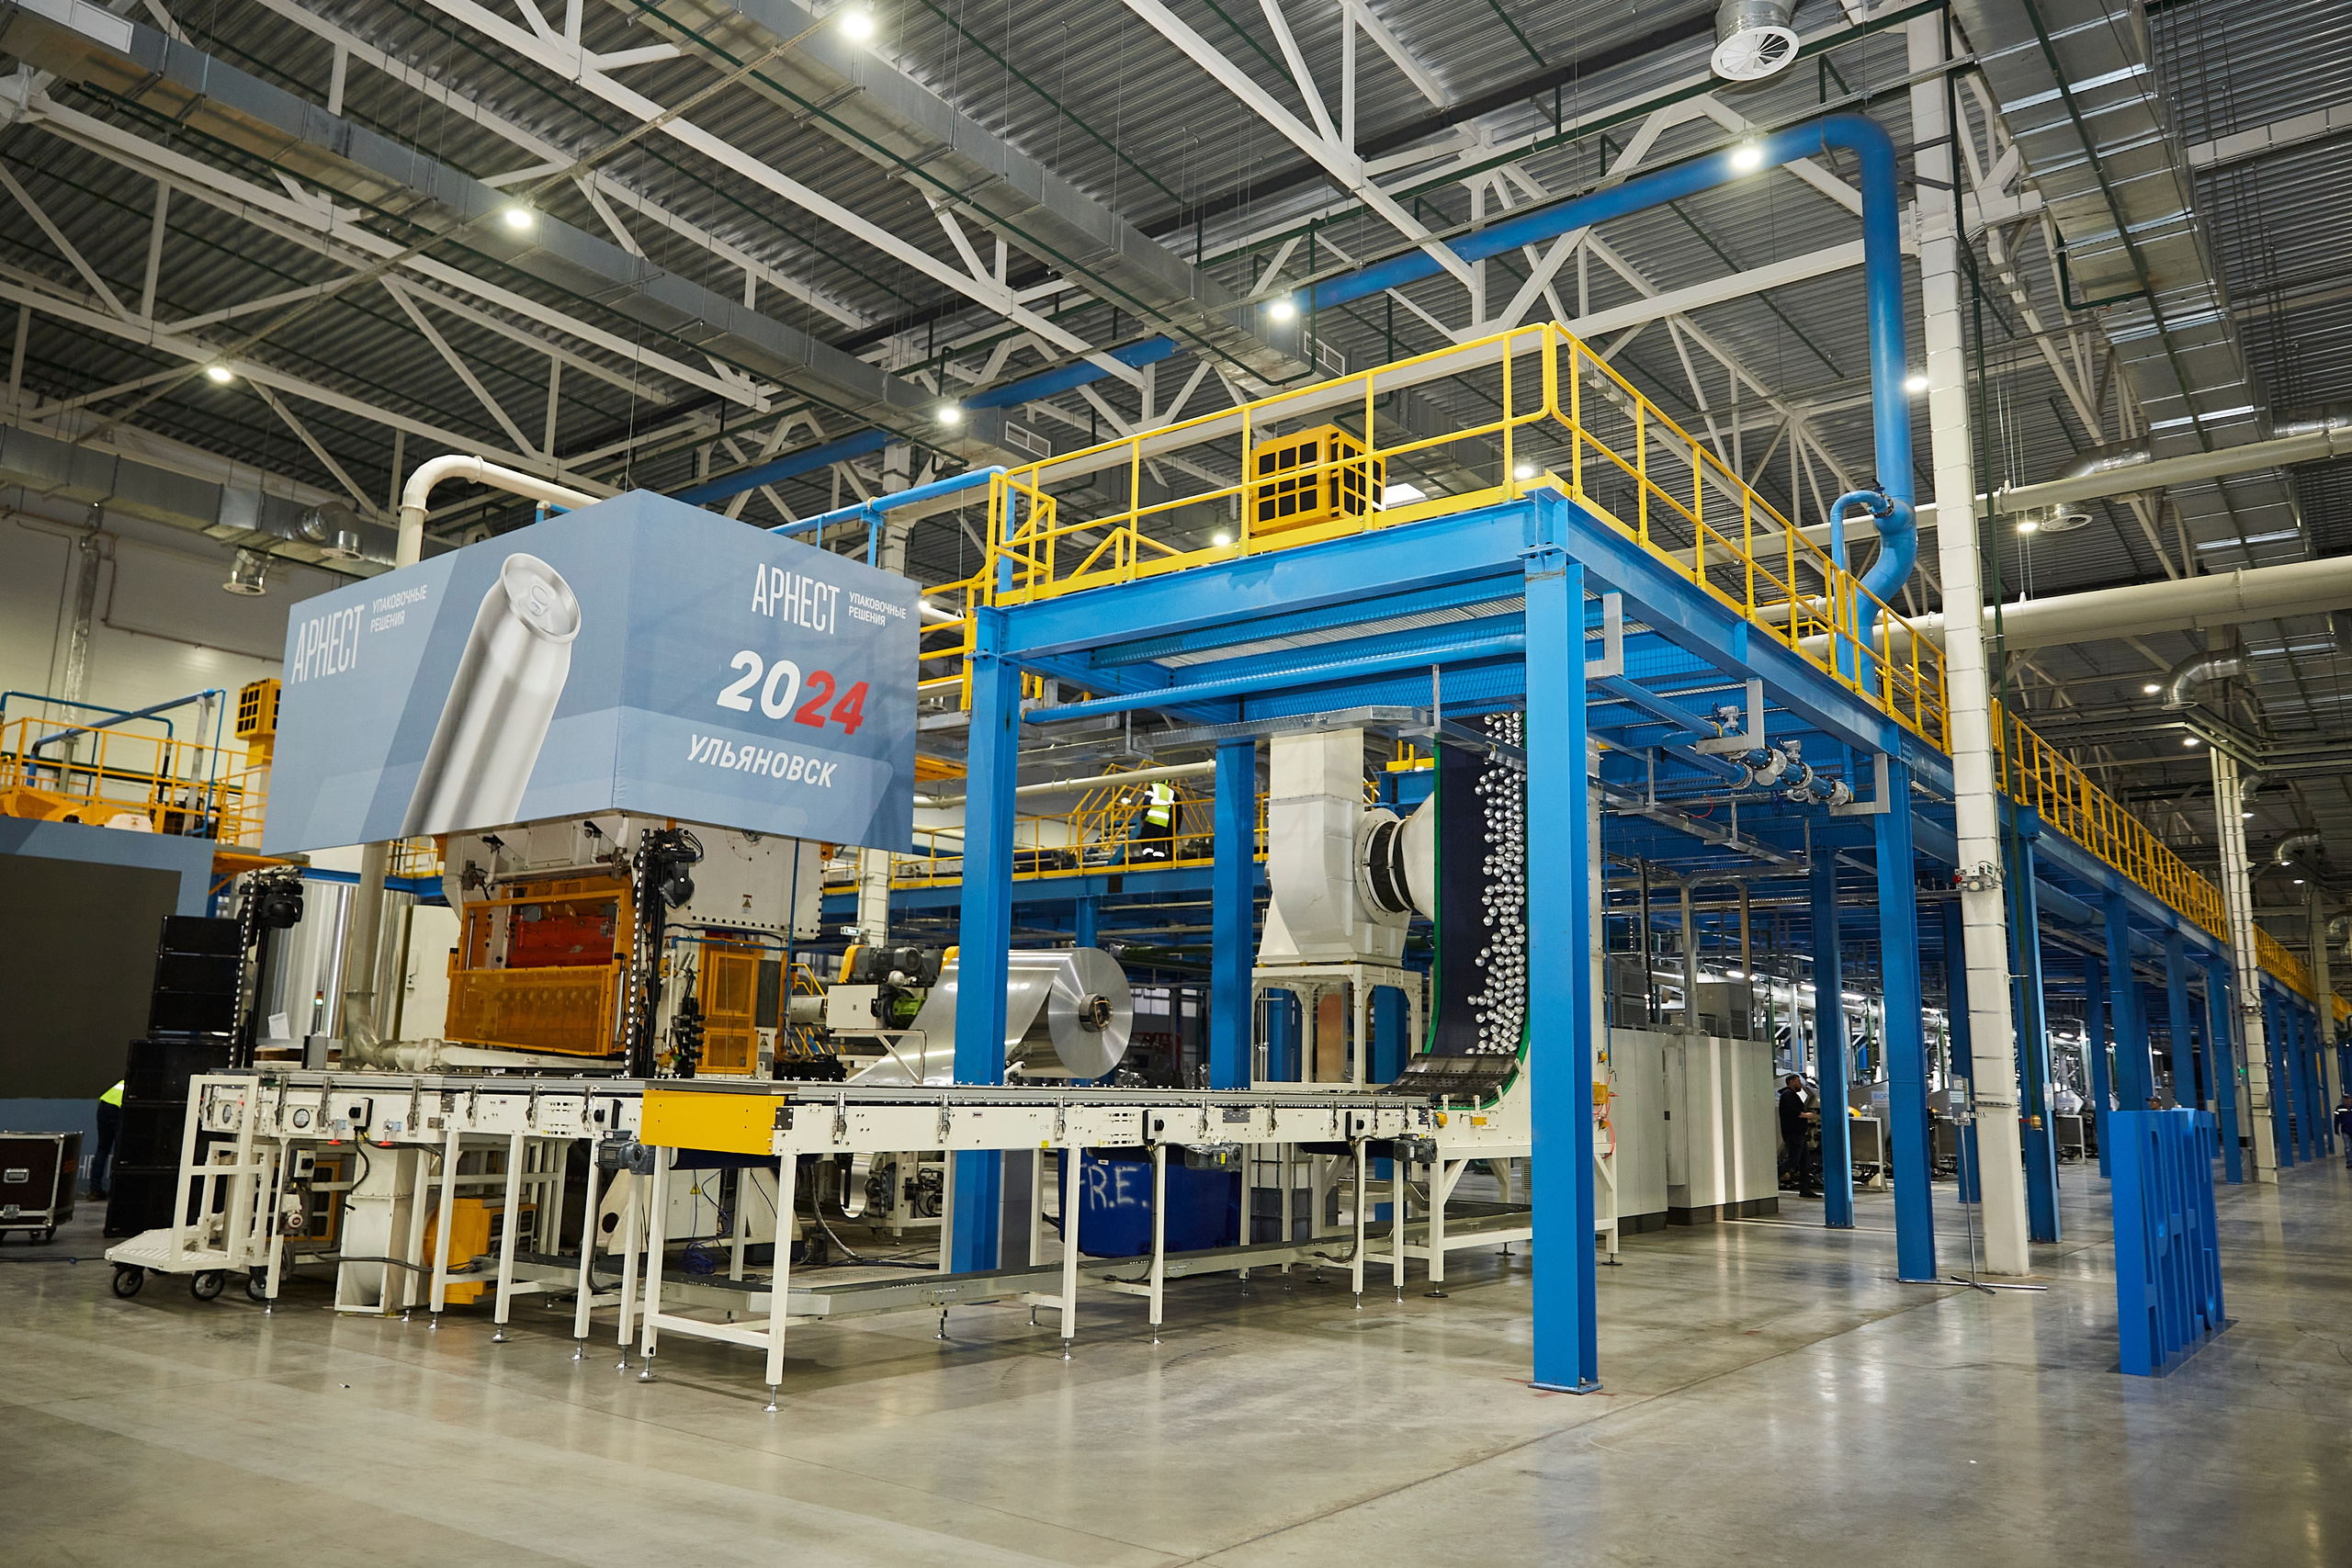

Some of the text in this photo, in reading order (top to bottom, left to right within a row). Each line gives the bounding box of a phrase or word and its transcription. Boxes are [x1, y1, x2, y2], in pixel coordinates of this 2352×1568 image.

[372, 584, 427, 614] УПАКОВОЧНЫЕ
[752, 562, 840, 635] АРНЕСТ
[848, 605, 886, 626] РЕШЕНИЯ
[849, 591, 907, 619] УПАКОВОЧНЫЕ
[370, 610, 405, 633] РЕШЕНИЯ
[291, 604, 365, 684] АРНЕСТ
[717, 649, 870, 735] 2024
[687, 734, 838, 787] УЛЬЯНОВСК
